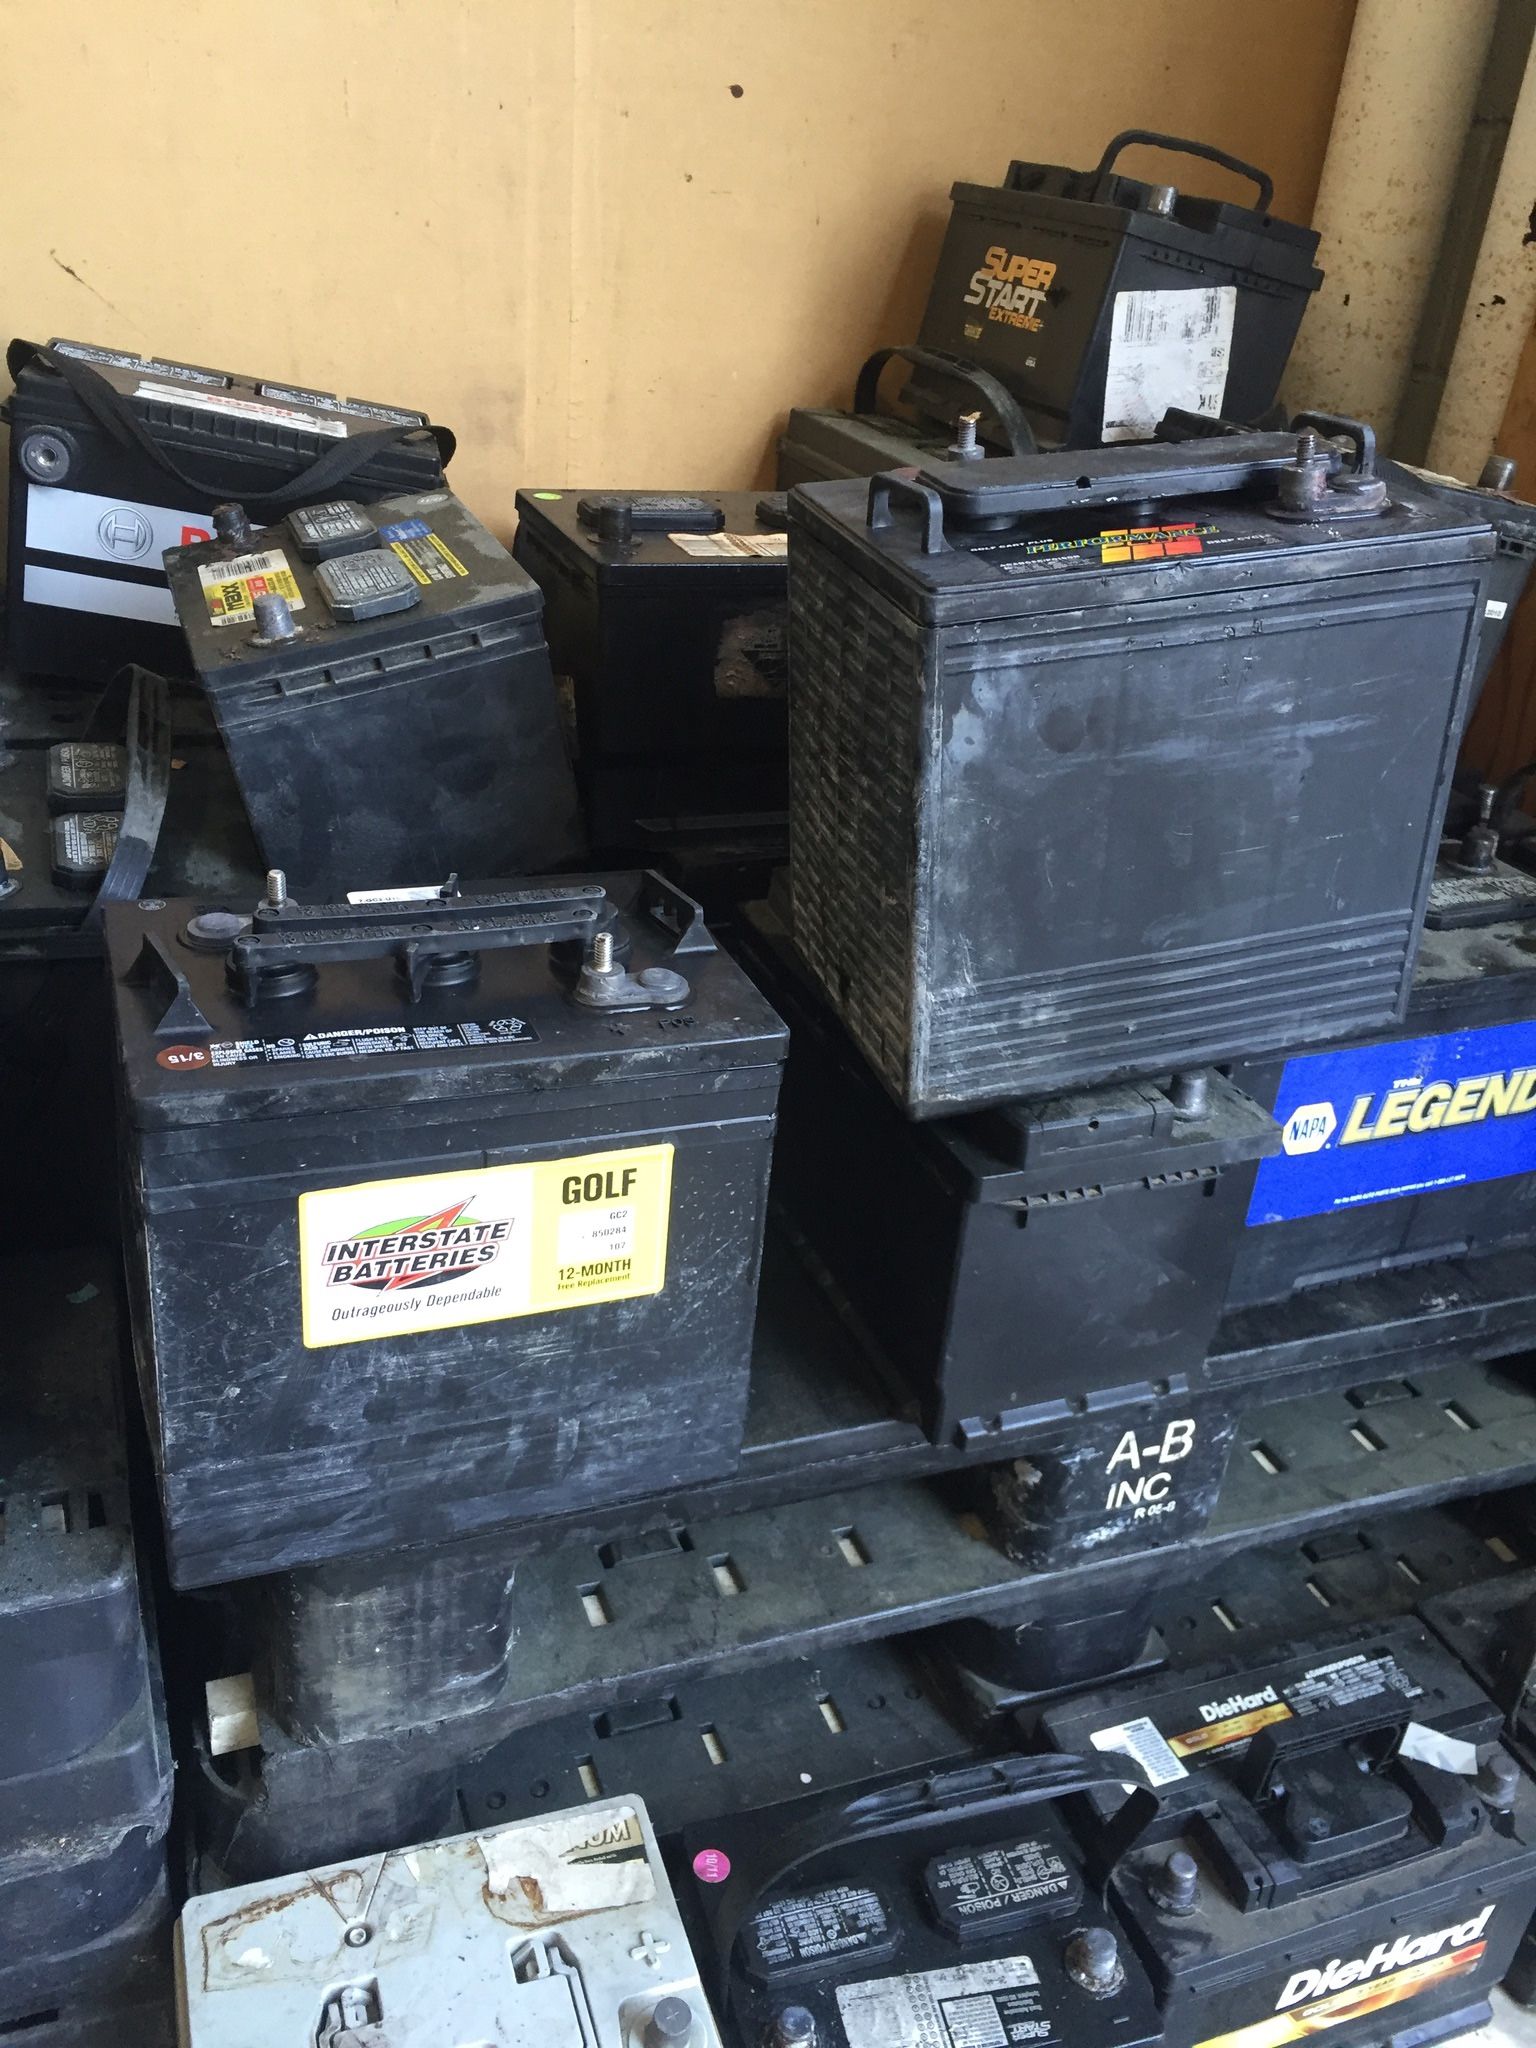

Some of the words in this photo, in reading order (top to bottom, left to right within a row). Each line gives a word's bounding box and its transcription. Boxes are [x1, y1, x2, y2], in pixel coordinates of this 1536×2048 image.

[980, 246, 1057, 290] SUPER
[963, 270, 1047, 317] START
[988, 306, 1041, 332] EXTREME
[1026, 525, 1219, 555] PERFORMANCE
[317, 1027, 406, 1039] DANGER/POISON
[167, 1051, 205, 1064] 3/15
[1289, 1116, 1327, 1141] NAPA
[562, 1168, 638, 1204] GOLF
[610, 1210, 628, 1220] GC2
[327, 1222, 507, 1263] INTERSTATE
[610, 1241, 626, 1250] 107
[333, 1245, 498, 1283] BATTERIES
[559, 1258, 631, 1280] 12-MONTH
[557, 1282, 575, 1290] Free
[577, 1273, 630, 1287] Replacement
[331, 1297, 421, 1321] Outrageously
[427, 1286, 502, 1308] Dependable
[1105, 1418, 1196, 1475] A-B
[1105, 1472, 1172, 1510] INC
[1199, 1685, 1279, 1723] DieHard
[705, 1853, 718, 1878] 10/11
[958, 1898, 1002, 1915] POISON
[1010, 1884, 1059, 1903] DANGER
[799, 1935, 859, 1958] DANGER/POISON
[1275, 1904, 1496, 2010] DieHard
